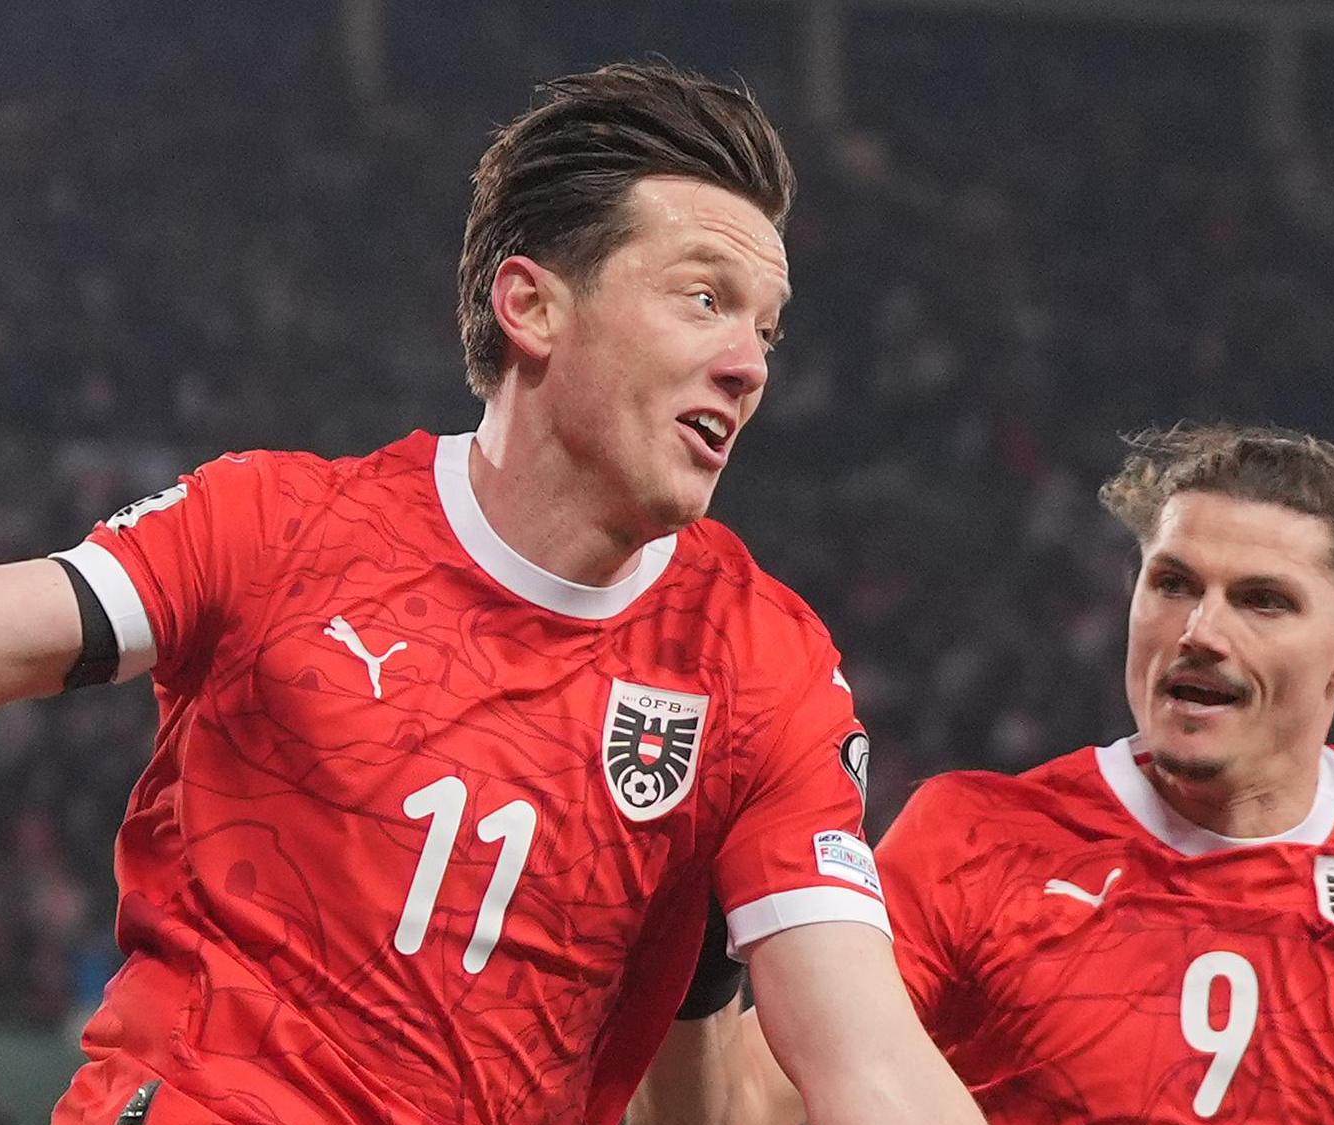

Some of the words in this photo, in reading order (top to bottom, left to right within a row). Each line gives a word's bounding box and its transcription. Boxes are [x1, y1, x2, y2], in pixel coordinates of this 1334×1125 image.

[639, 695, 682, 713] ÖFB
[395, 776, 537, 974] 11
[1180, 951, 1259, 1118] 9
